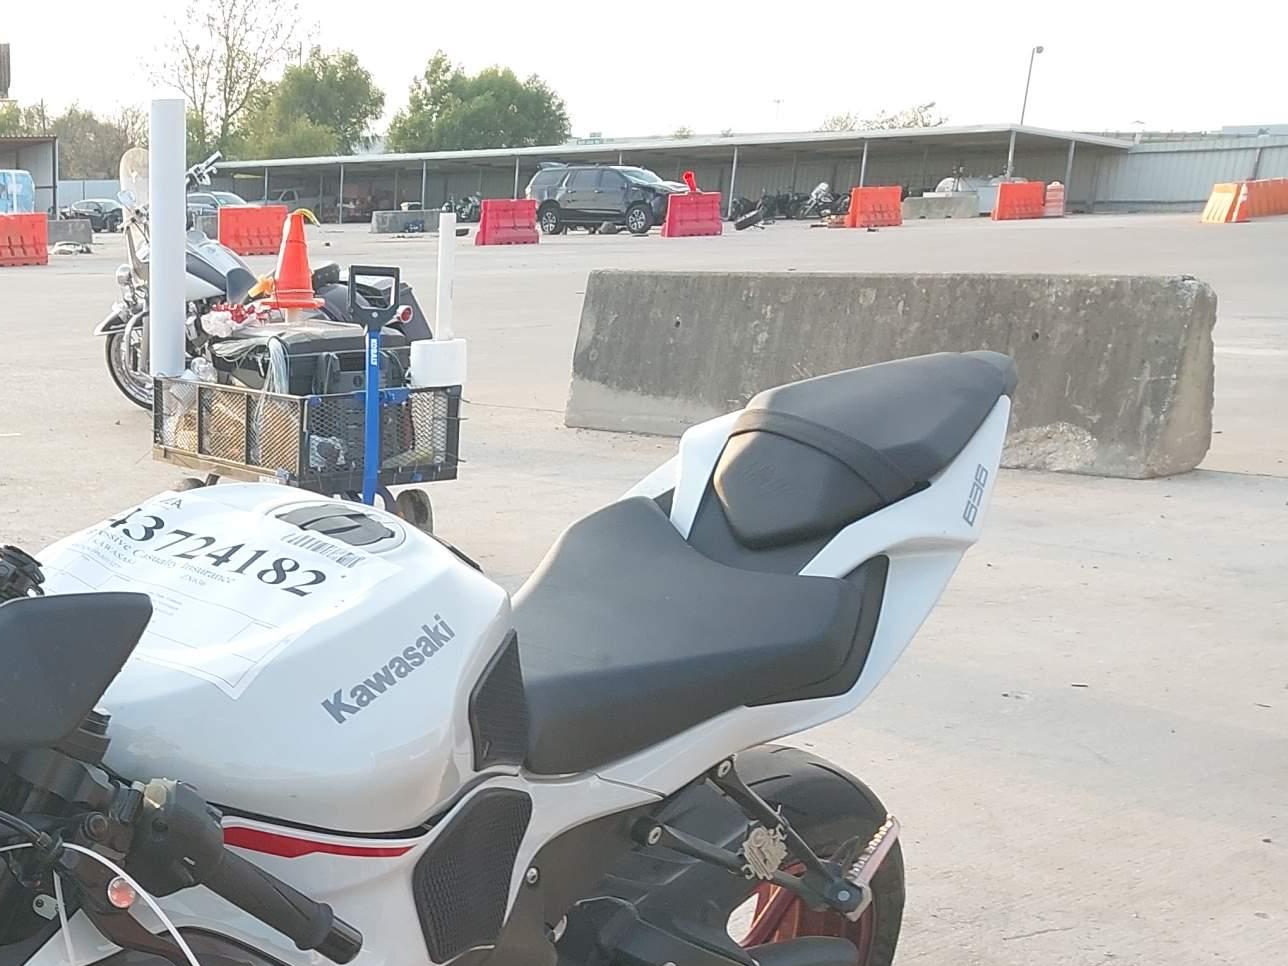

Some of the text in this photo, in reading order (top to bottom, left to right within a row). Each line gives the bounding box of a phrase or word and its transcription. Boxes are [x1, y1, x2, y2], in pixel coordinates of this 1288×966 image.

[963, 464, 988, 527] 636
[108, 507, 326, 597] 43724182
[321, 614, 455, 724] Kawasaki
